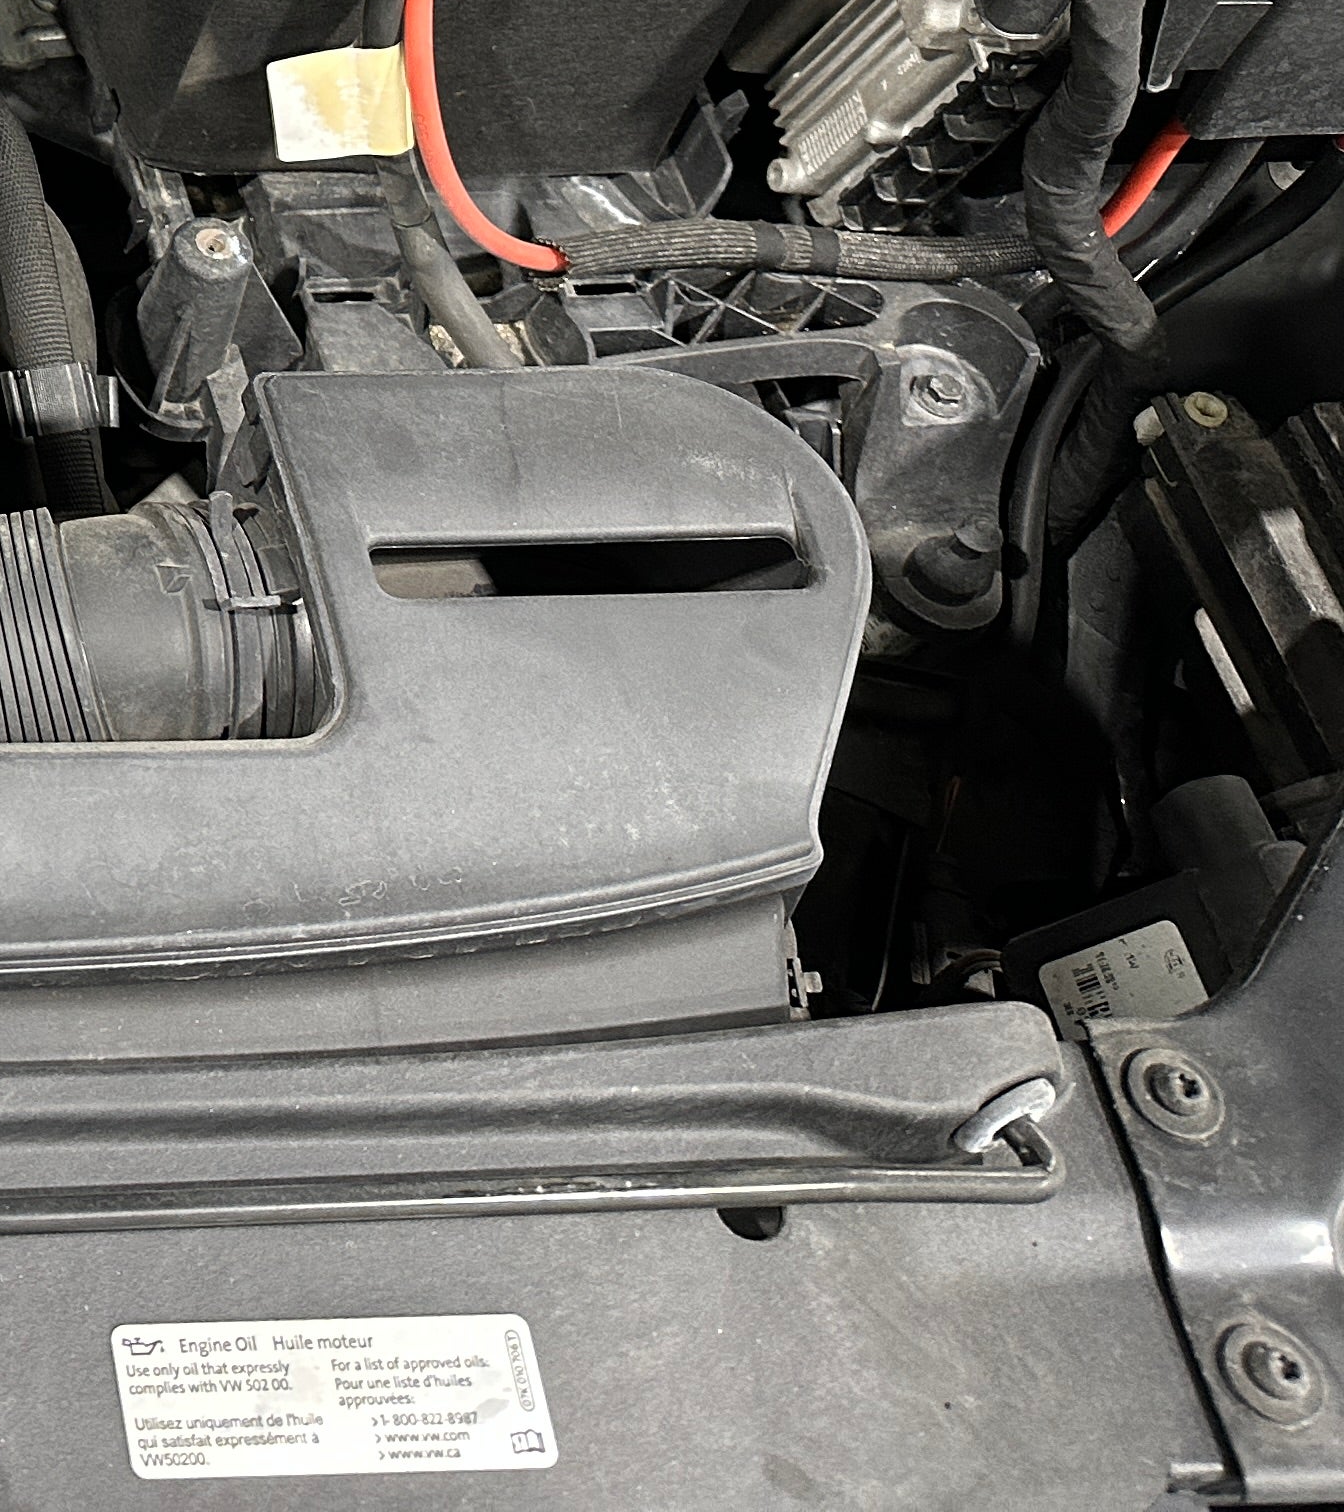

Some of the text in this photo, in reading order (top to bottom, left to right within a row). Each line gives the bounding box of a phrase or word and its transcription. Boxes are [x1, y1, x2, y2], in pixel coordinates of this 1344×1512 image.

[179, 1334, 373, 1357] Engine Oil Huile moteur
[126, 1360, 290, 1380] Use only oil that expressly
[331, 1358, 351, 1372] For
[354, 1360, 361, 1371] a
[364, 1357, 383, 1371] list
[387, 1356, 400, 1370] of
[403, 1356, 461, 1373] approved
[129, 1378, 293, 1398] complies with VW 502 00.
[335, 1374, 472, 1390] Pour une liste d'huiles
[135, 1413, 324, 1433] Utilisez uniquement de l'huile
[137, 1431, 320, 1451] qui satisfait expressément à
[385, 1431, 470, 1442] www.vw.com
[388, 1448, 461, 1460] www.vw.ca
